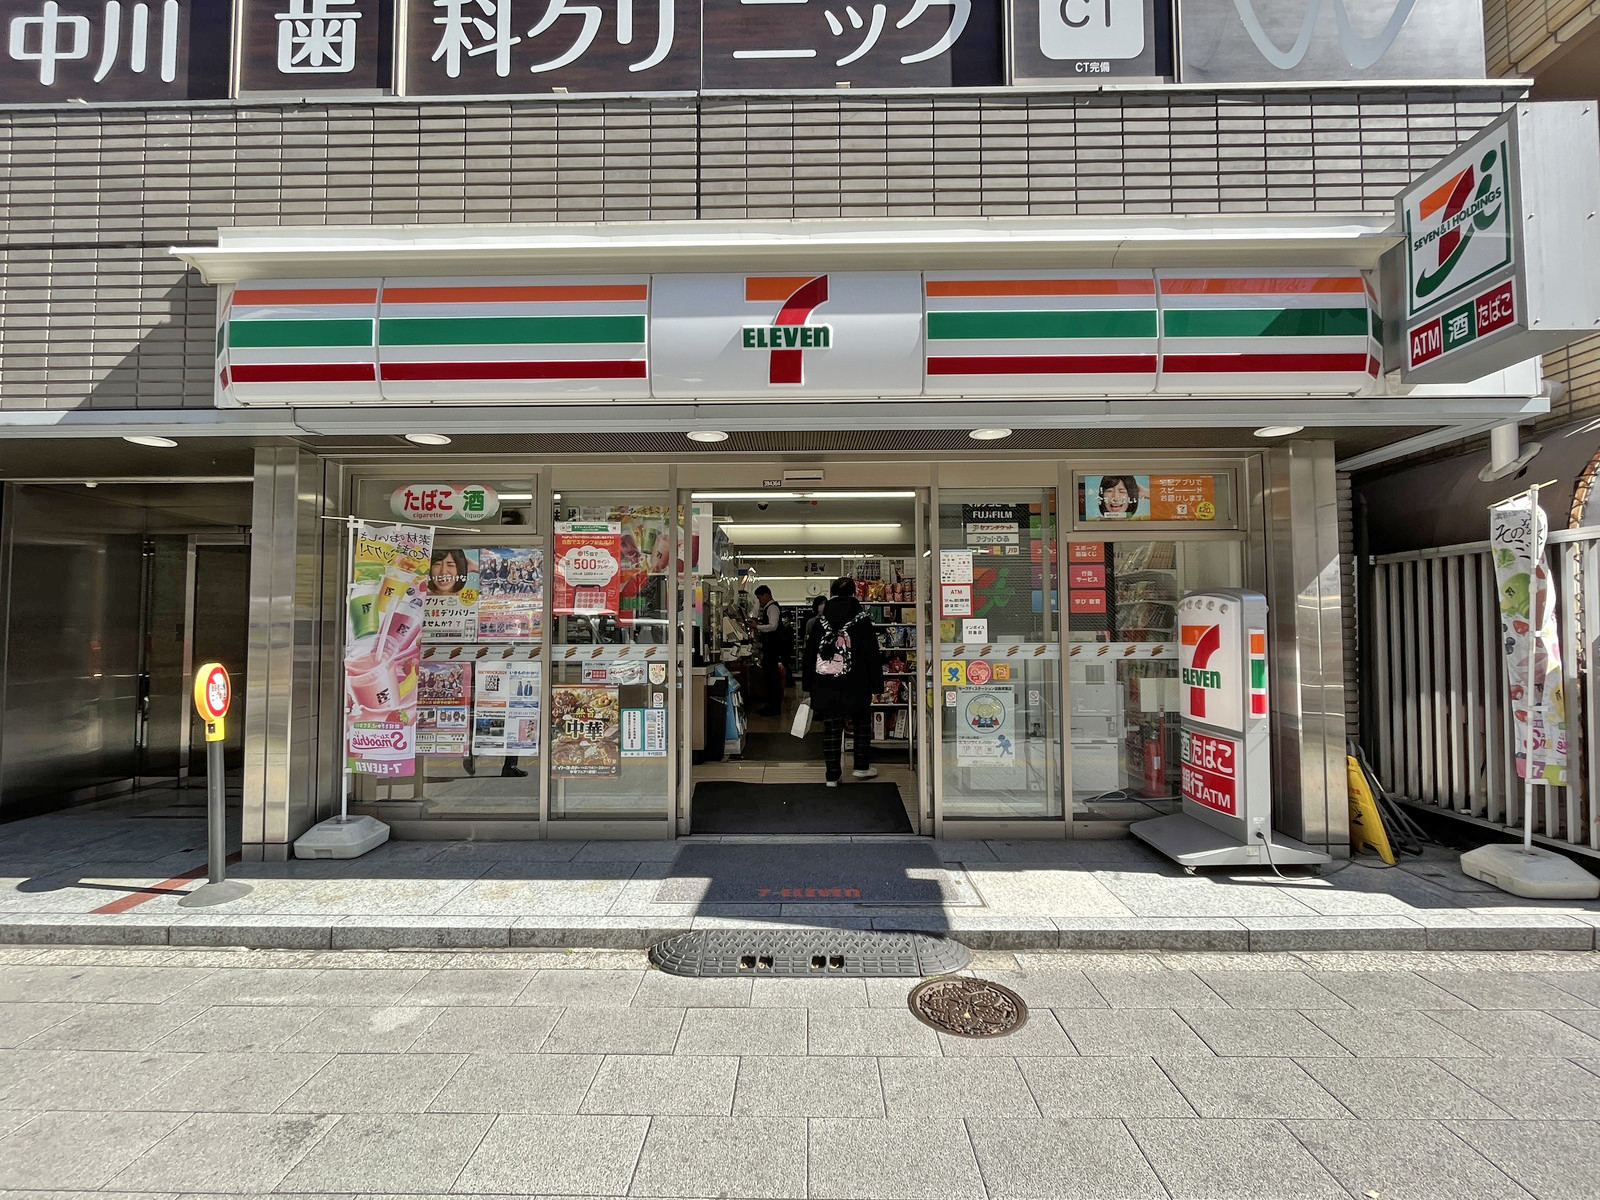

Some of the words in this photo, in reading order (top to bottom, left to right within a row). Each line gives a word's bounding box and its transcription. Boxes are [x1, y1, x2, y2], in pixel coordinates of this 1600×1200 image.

[1075, 62, 1110, 72] CT完備
[1452, 187, 1502, 230] HOLDINGS
[1477, 292, 1513, 327] たばこ
[1449, 311, 1469, 343] 酒
[1413, 326, 1440, 358] ATM
[404, 489, 453, 511] たばこ
[463, 490, 485, 511] 酒
[574, 559, 596, 570] 500
[424, 609, 476, 618] 気軽デリバリー
[566, 718, 605, 741] 中華
[1192, 737, 1234, 774] たばこ
